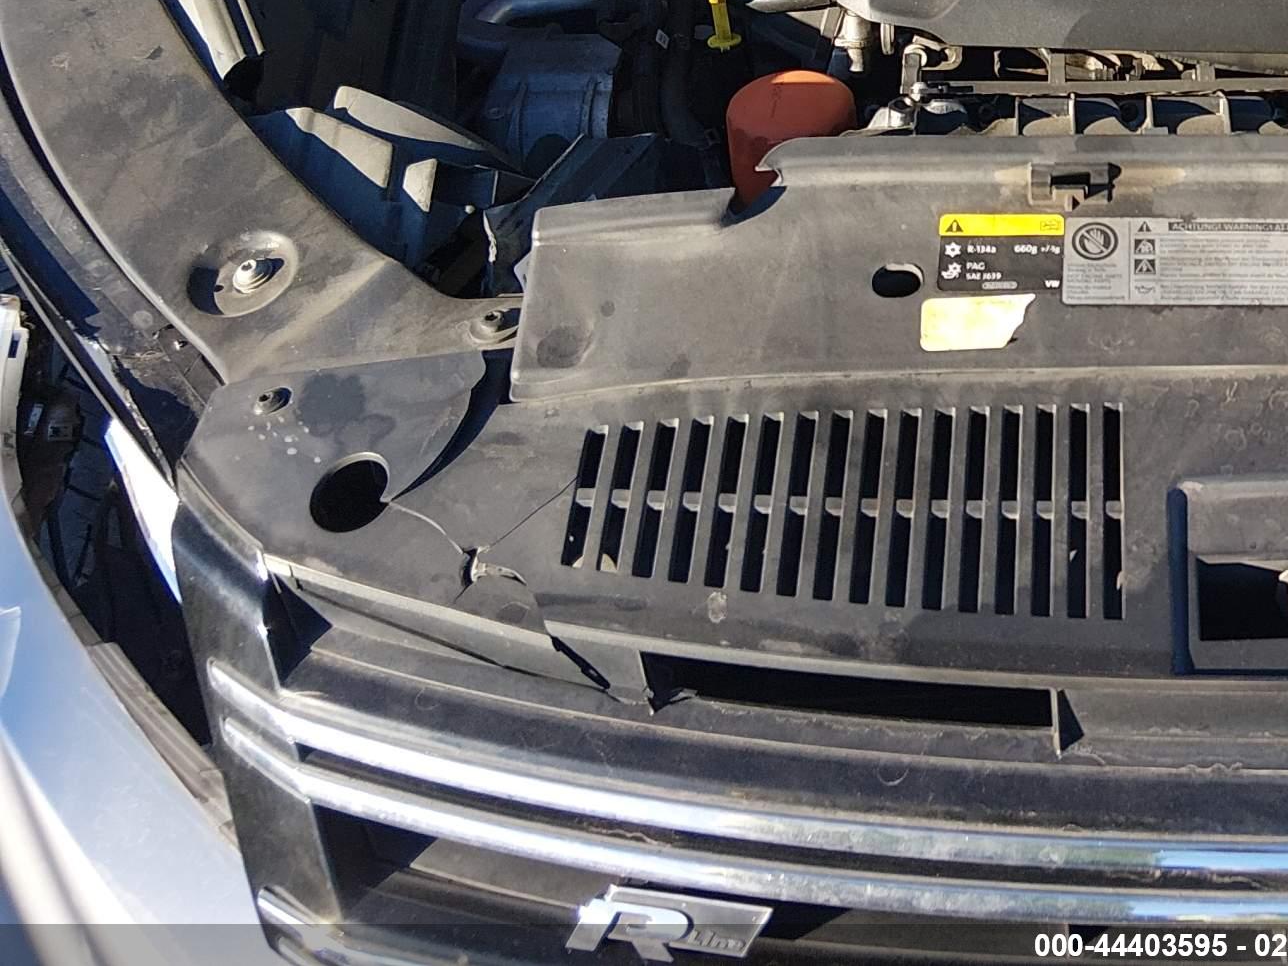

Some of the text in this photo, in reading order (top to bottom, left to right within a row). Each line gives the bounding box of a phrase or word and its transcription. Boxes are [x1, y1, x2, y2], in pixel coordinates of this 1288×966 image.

[1013, 244, 1038, 255] 660g
[965, 262, 986, 271] PAG
[965, 272, 981, 281] SAE
[565, 898, 690, 963] R
